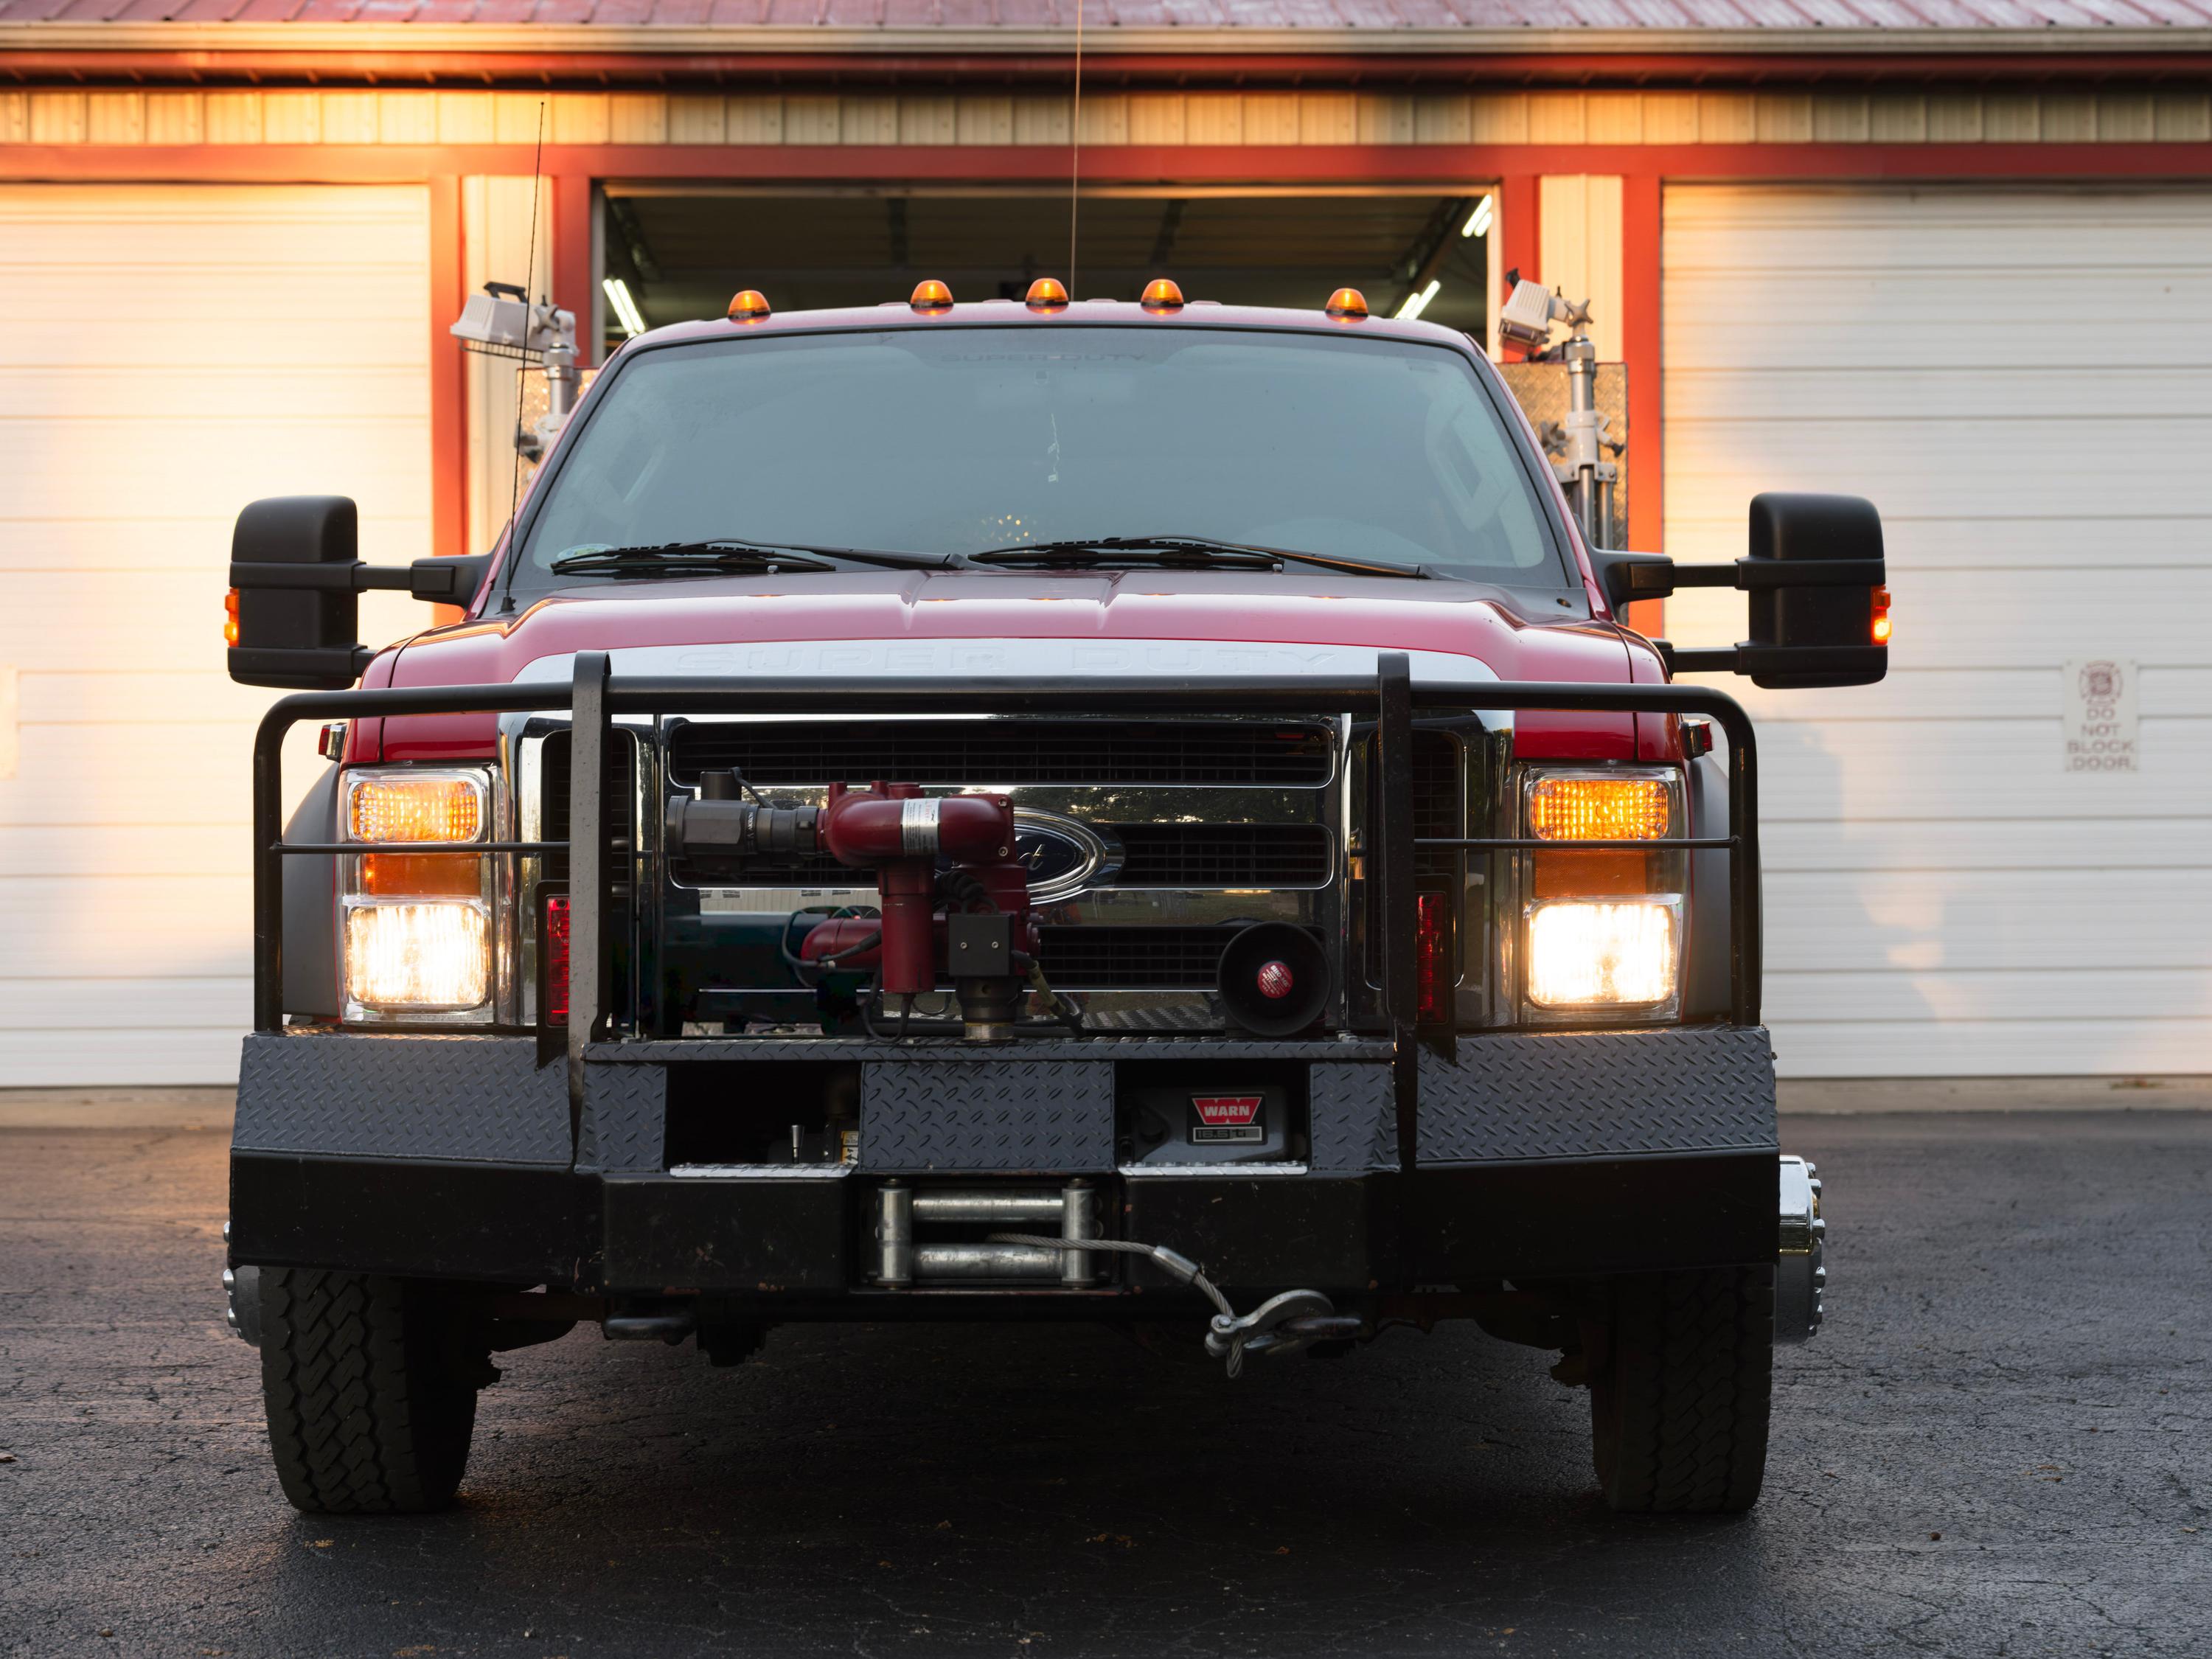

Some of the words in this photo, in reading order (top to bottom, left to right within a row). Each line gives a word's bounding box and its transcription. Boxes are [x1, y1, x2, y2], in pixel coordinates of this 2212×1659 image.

[675, 647, 1009, 674] SUPER
[1071, 647, 1338, 674] DUTY
[2087, 708, 2115, 720] DO
[2081, 723, 2122, 737] NOT
[2067, 739, 2135, 754] BLOCK
[2073, 755, 2130, 771] DOOR
[1203, 1105, 1250, 1116] WARN
